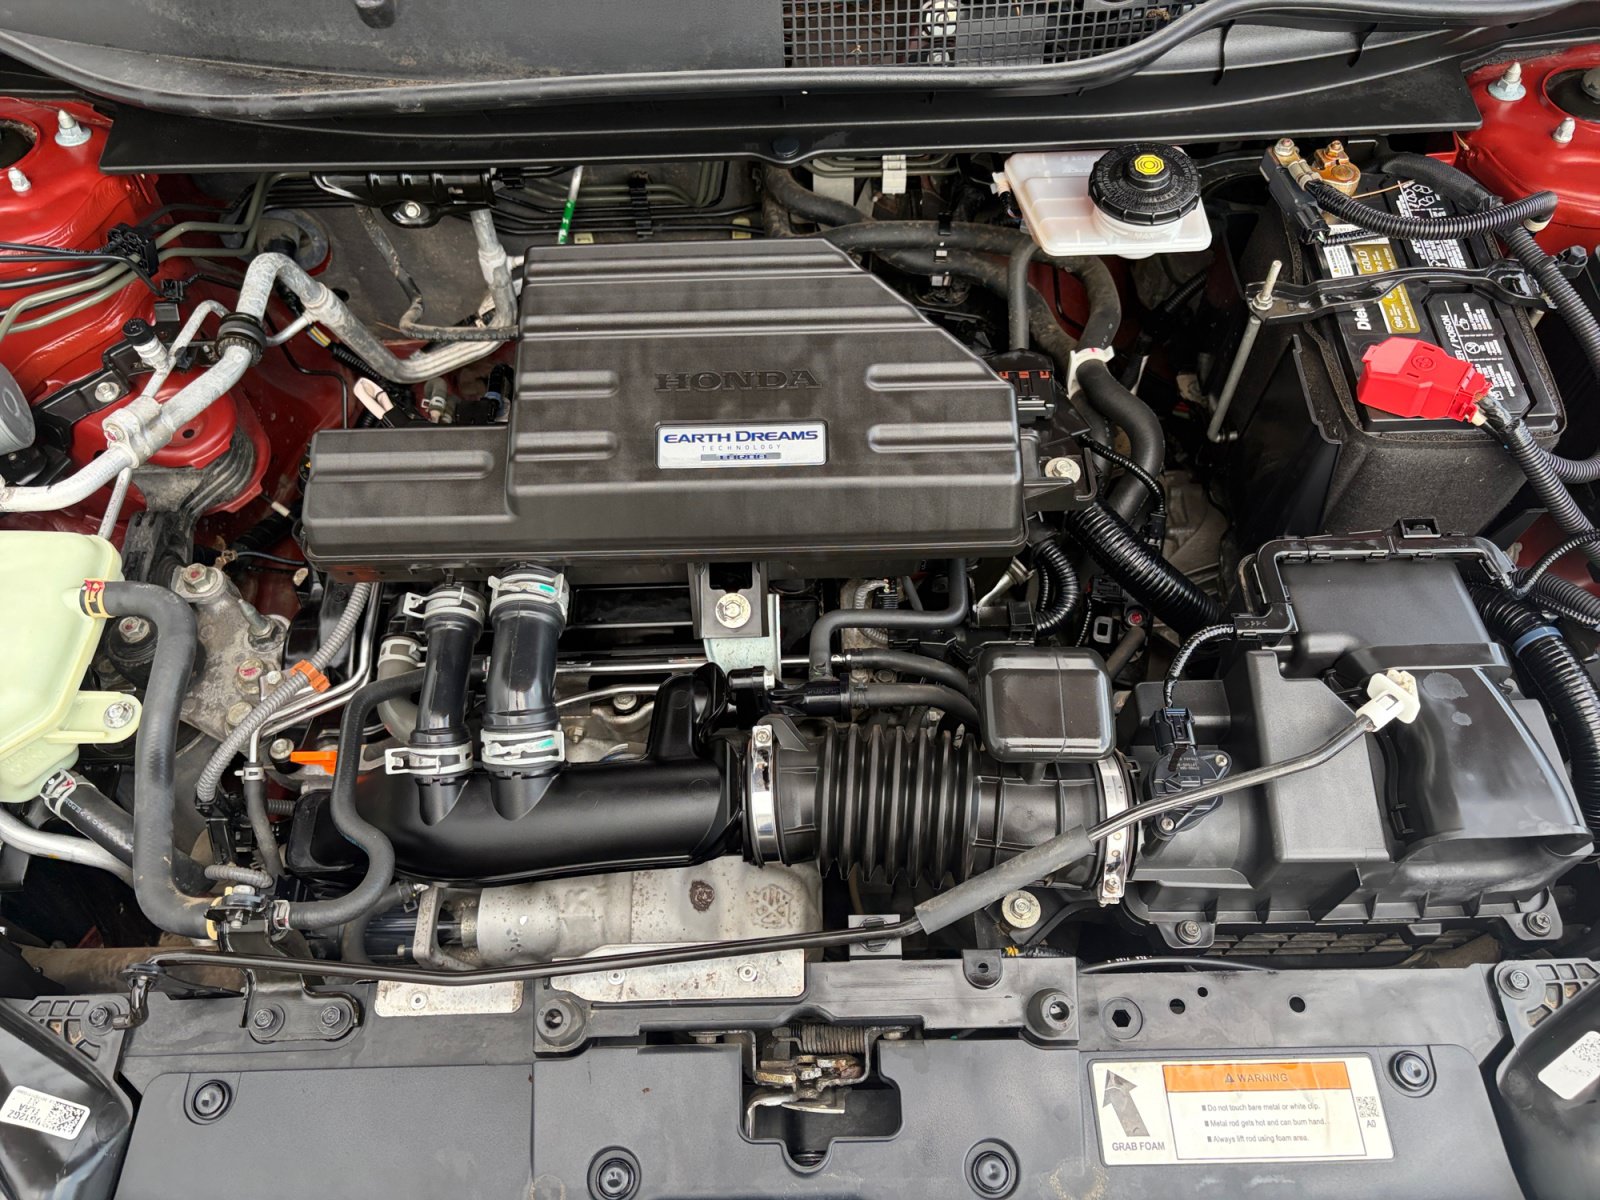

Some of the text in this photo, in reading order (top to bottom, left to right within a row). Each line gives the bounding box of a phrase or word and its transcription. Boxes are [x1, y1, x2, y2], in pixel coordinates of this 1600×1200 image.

[1358, 250, 1373, 272] GOLD
[1440, 314, 1459, 343] POISON
[655, 369, 822, 392] HONDA
[664, 430, 818, 443] EARTH DREAMS
[702, 443, 781, 451] TECHNOLOGY
[1237, 1073, 1288, 1082] WARNING
[1229, 1103, 1247, 1111] touch
[1248, 1103, 1262, 1111] bare
[1290, 1102, 1306, 1110] white
[1308, 1102, 1320, 1111] clip.
[1210, 1119, 1228, 1127] Metal
[1241, 1119, 1255, 1128] gets
[1309, 1118, 1327, 1126] hand.
[1213, 1135, 1236, 1144] Always
[1236, 1135, 1246, 1143] lift
[1257, 1135, 1276, 1144] using
[1275, 1134, 1292, 1142] foam
[1112, 1141, 1166, 1151] GRAB FOAM
